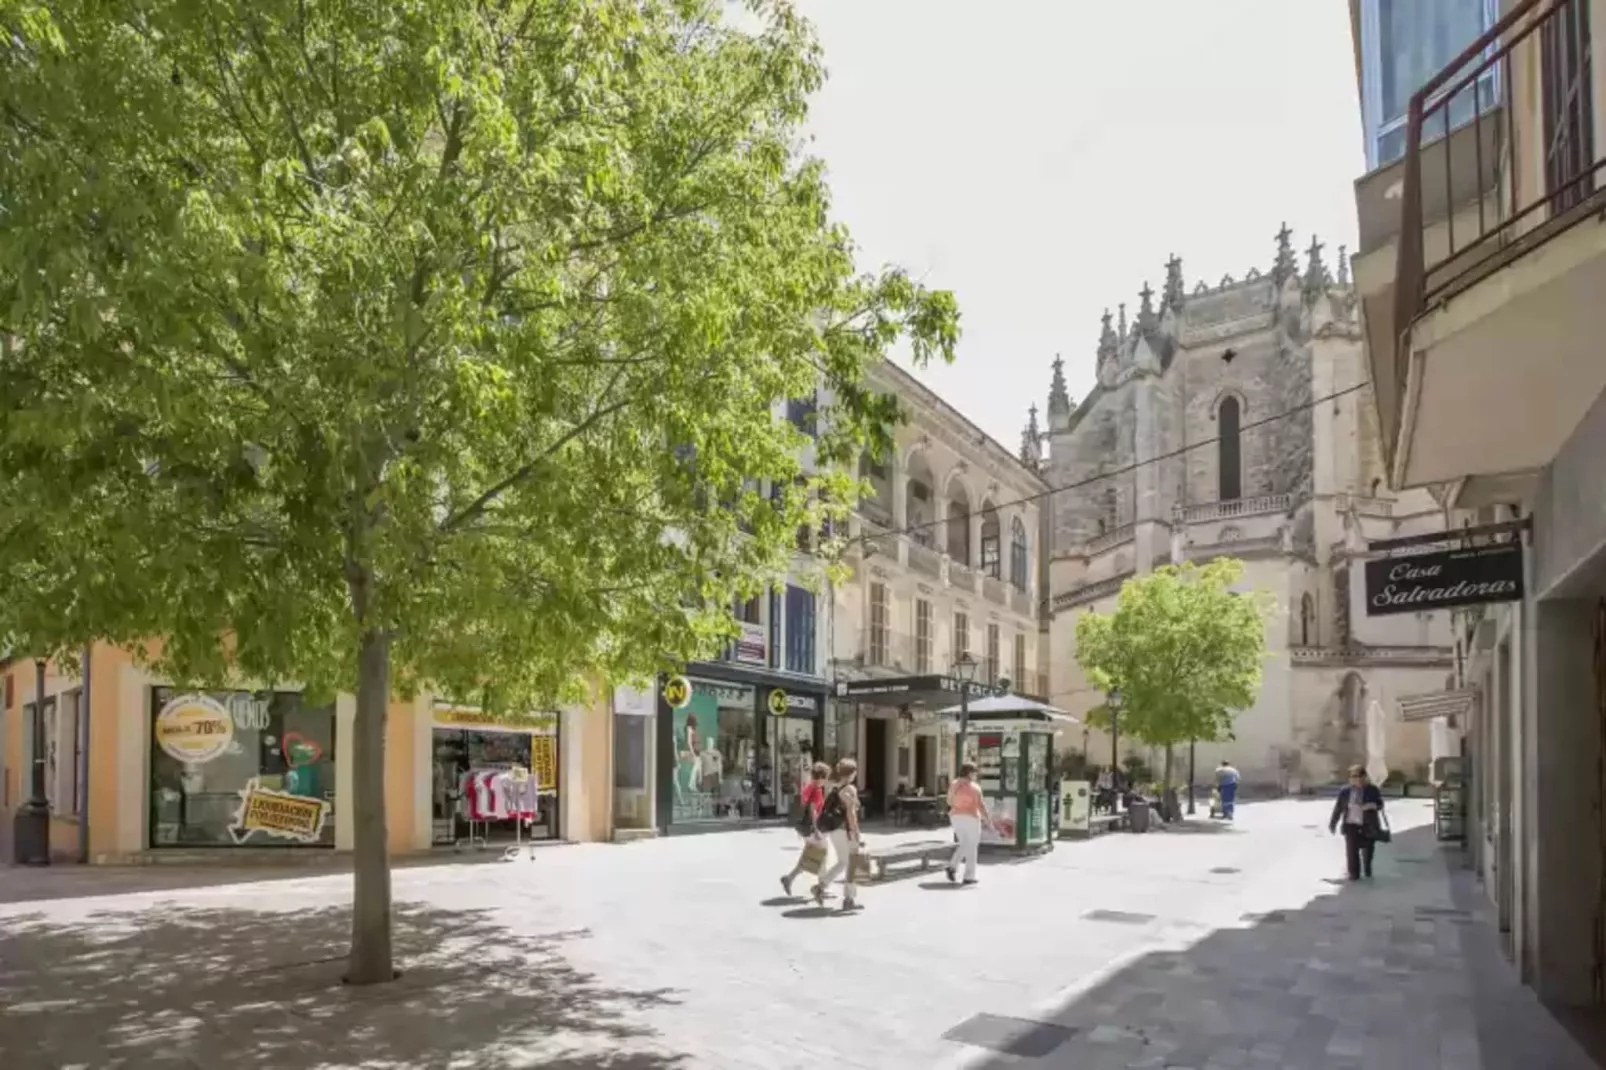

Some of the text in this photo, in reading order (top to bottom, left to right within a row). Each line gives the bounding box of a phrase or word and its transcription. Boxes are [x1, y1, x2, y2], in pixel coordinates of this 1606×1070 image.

[1389, 562, 1443, 581] Casa
[1373, 580, 1517, 607] Salvadoras
[194, 720, 227, 735] 70%
